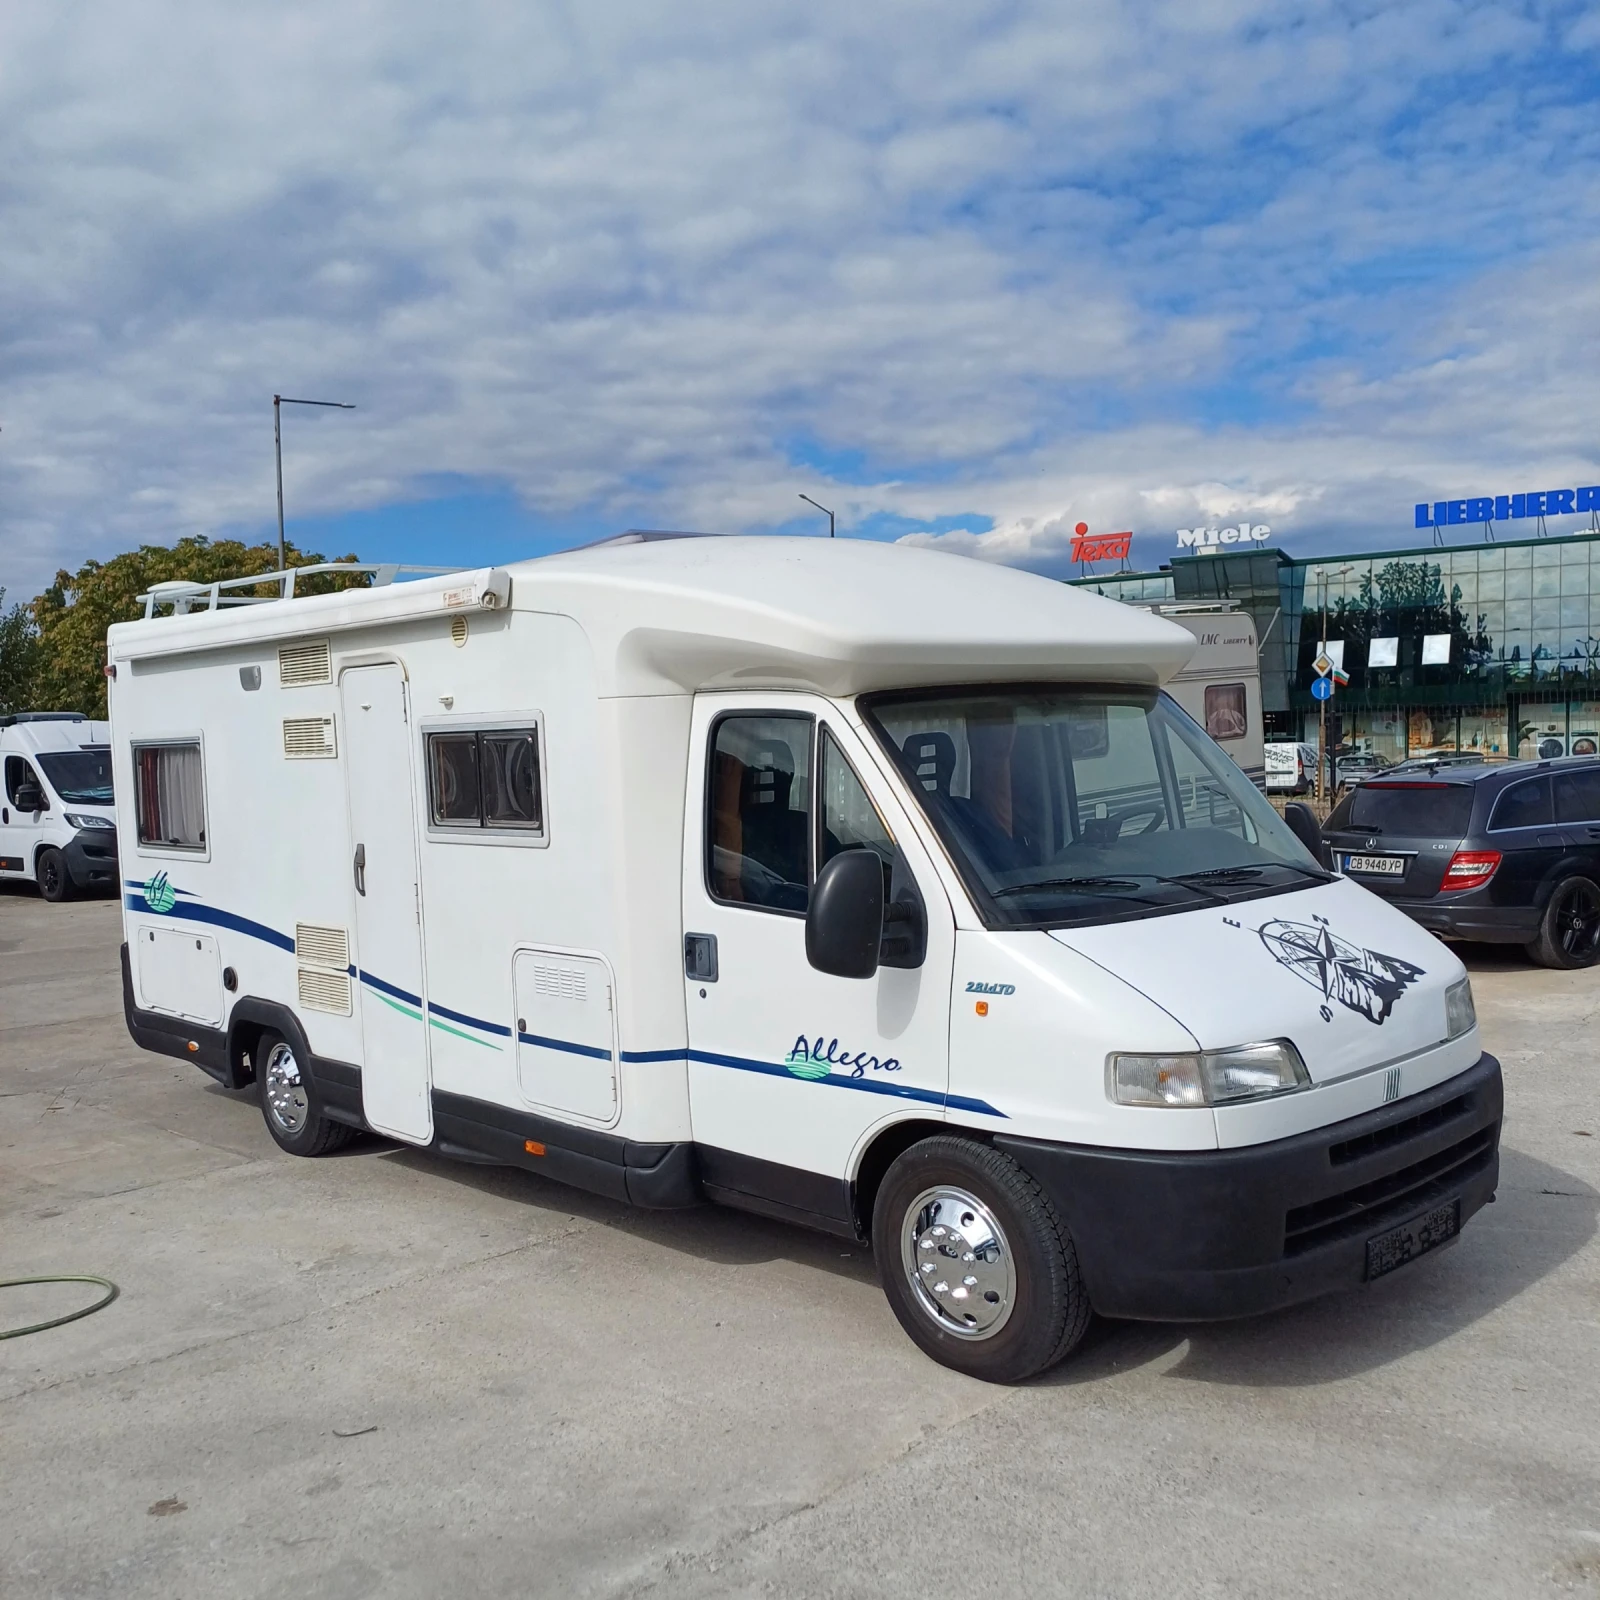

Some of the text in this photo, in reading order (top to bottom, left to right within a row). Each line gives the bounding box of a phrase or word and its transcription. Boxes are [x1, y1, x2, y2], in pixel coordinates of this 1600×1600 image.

[1415, 486, 1600, 528] LIEBHERR
[1070, 522, 1133, 563] Teka
[1176, 523, 1271, 548] Miele
[1200, 633, 1220, 646] LMC
[1350, 858, 1402, 872] CB 9448 XP
[1222, 916, 1241, 929] E
[1319, 1004, 1334, 1023] S
[790, 1034, 902, 1079] Allegro
